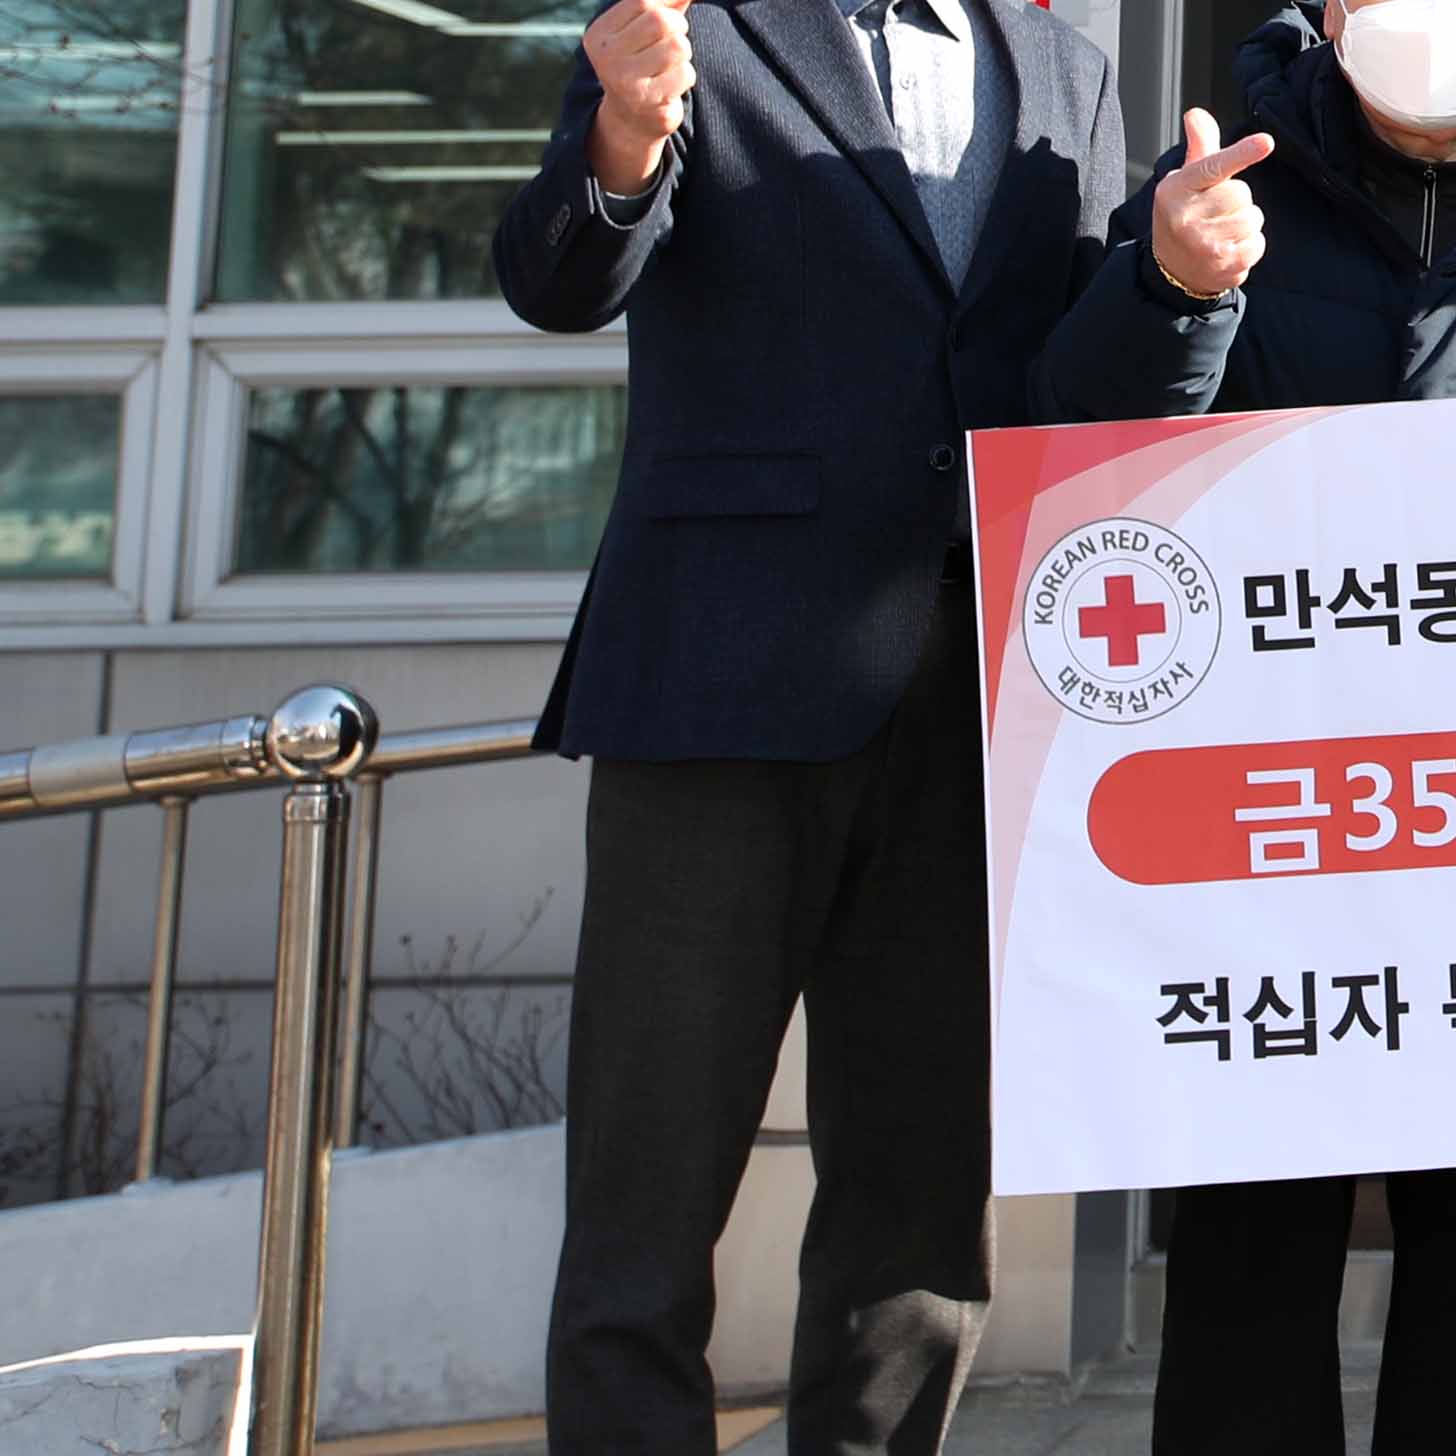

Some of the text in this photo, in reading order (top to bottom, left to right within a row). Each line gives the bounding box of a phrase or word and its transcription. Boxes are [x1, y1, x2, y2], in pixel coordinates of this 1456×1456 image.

[1034, 529, 1209, 625] KOREAN RED CROSS
[1057, 661, 1194, 715] 대한적십자사
[1156, 966, 1410, 1061] 적십자
